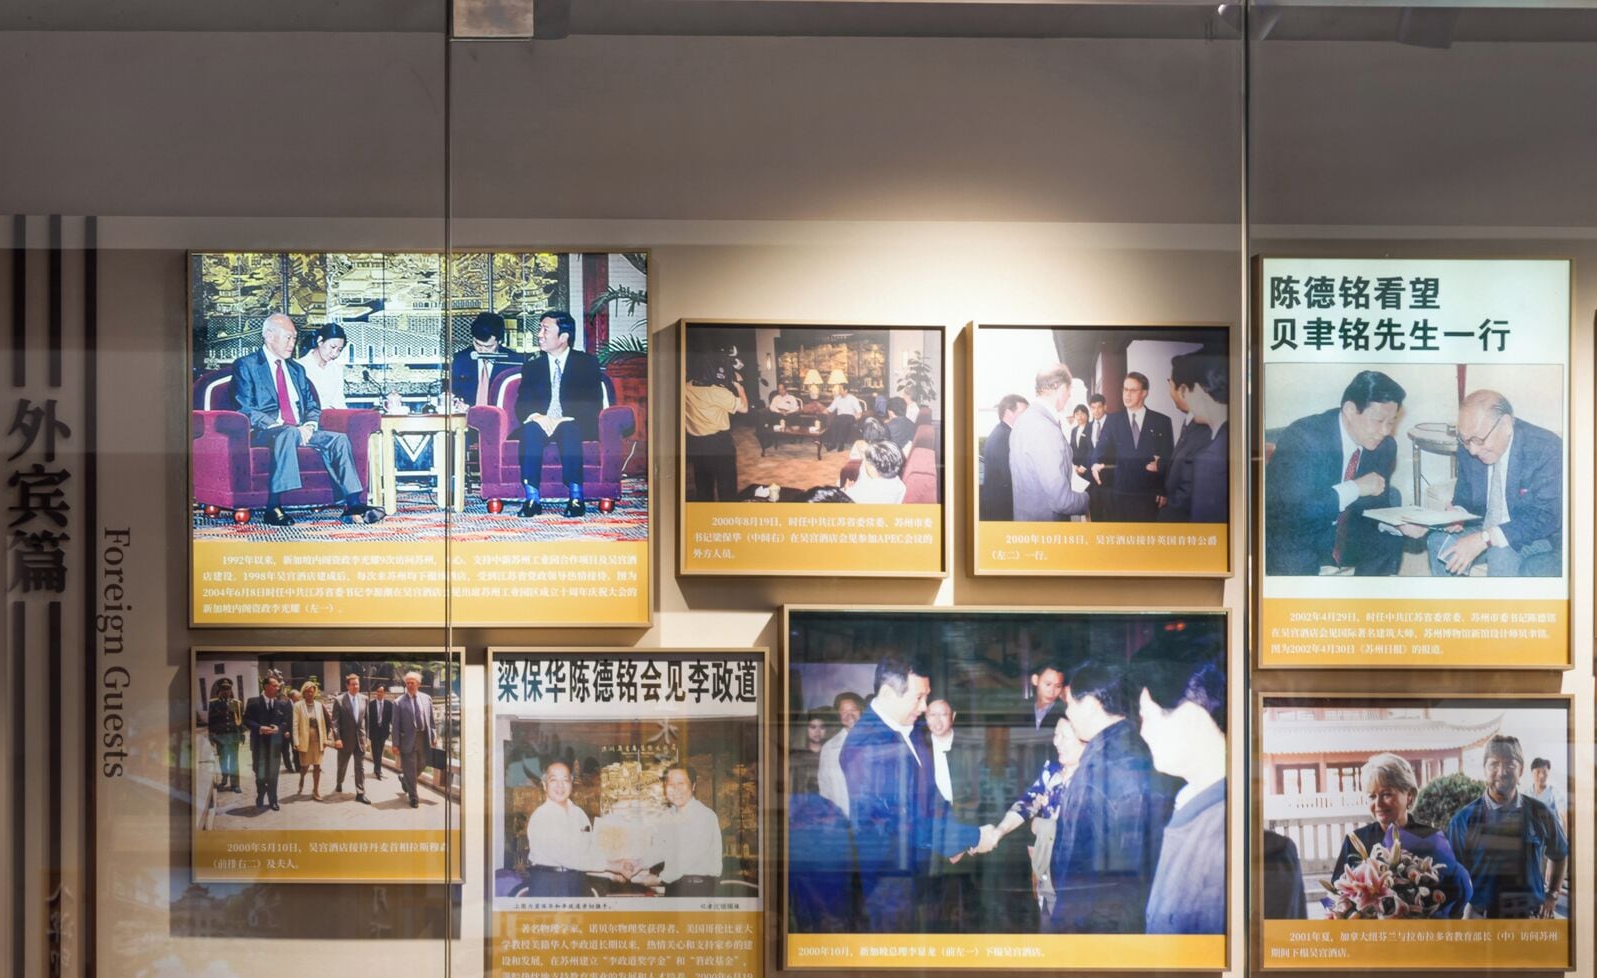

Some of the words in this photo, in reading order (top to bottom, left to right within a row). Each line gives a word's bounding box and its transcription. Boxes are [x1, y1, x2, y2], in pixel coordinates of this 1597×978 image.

[1270, 276, 1440, 309] 陈德铭看望
[1270, 317, 1510, 351] 贝聿铭先生一行
[7, 398, 71, 594] 外宾篇
[96, 527, 131, 654] Foreign
[498, 658, 757, 703] 梁保华陈德铭会见李政道
[103, 667, 131, 778] Guests
